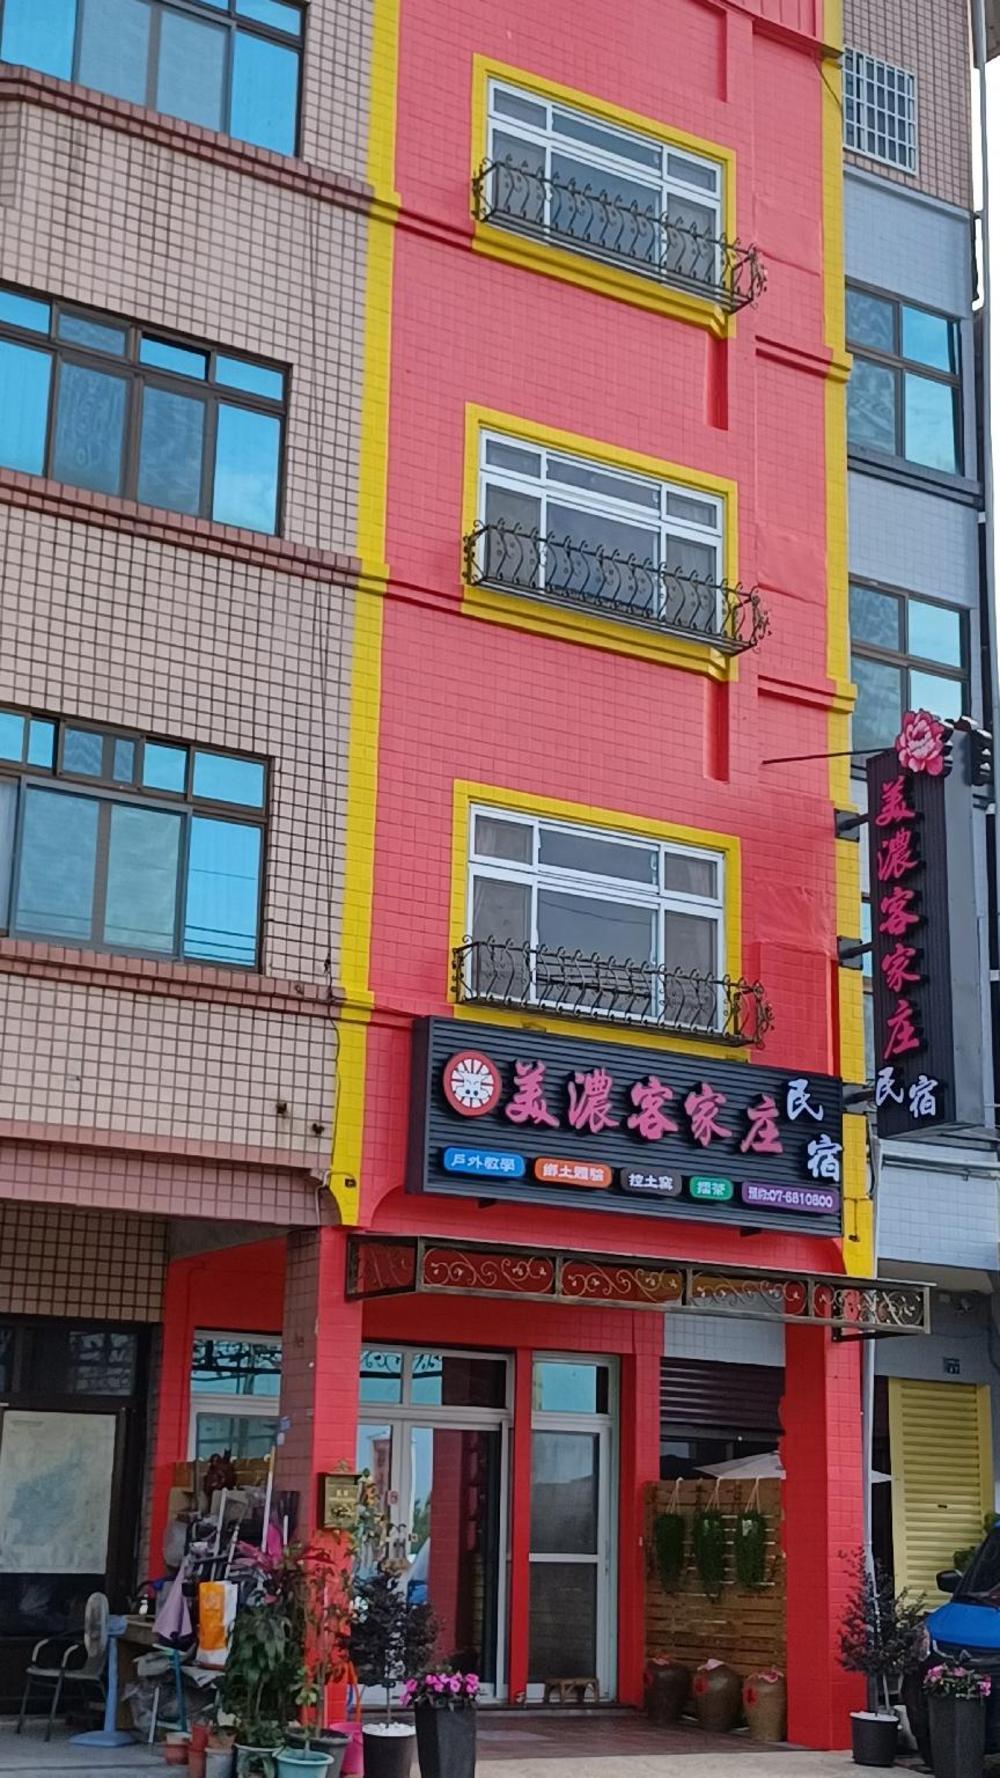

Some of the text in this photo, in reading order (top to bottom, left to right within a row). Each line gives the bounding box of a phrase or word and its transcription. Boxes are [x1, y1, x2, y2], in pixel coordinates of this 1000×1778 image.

[876, 775, 921, 1060] 美濃客家庄
[504, 1059, 784, 1154] 美濃客家庄
[786, 1078, 843, 1182] 民宿
[875, 1066, 938, 1119] 民宿
